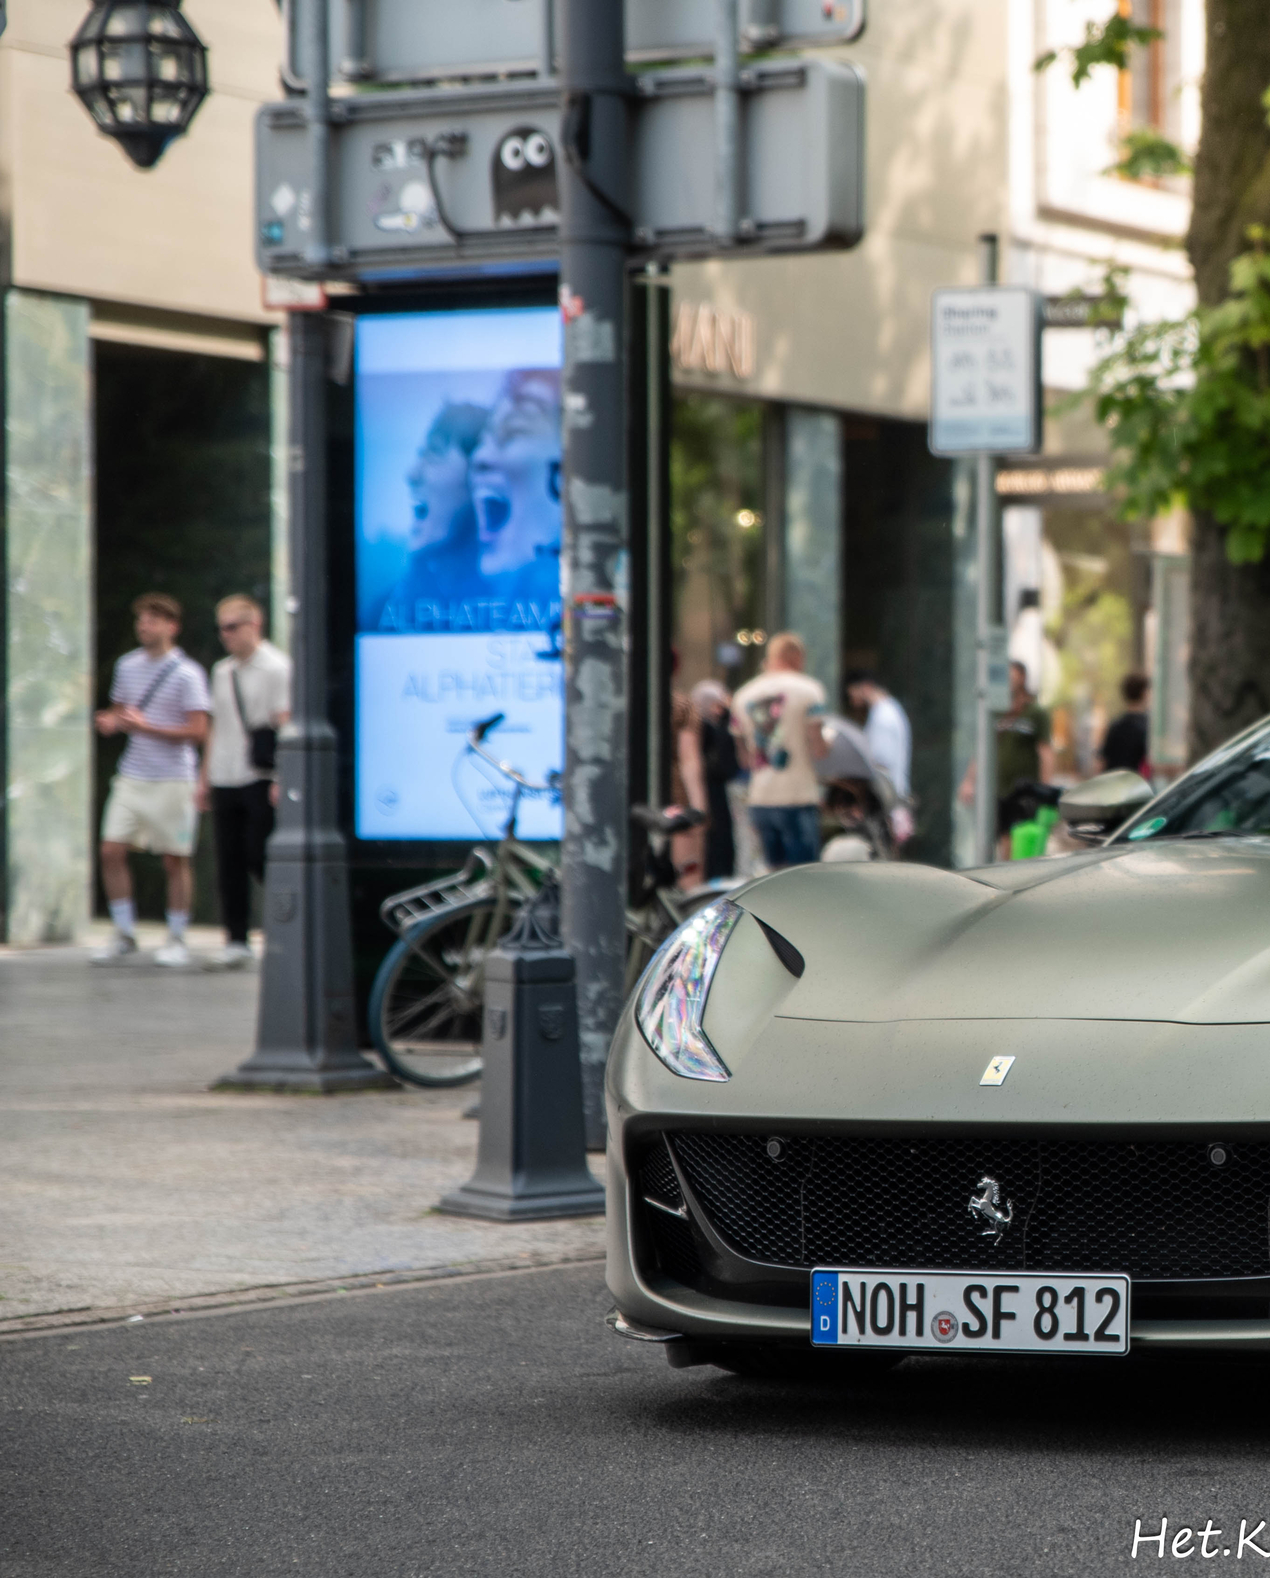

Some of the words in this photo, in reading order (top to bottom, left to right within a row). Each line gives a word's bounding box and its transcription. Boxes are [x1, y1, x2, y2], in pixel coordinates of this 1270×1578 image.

[820, 1315, 831, 1331] D
[841, 1280, 925, 1337] NOH
[961, 1283, 1020, 1340] SF
[1032, 1285, 1121, 1343] 812
